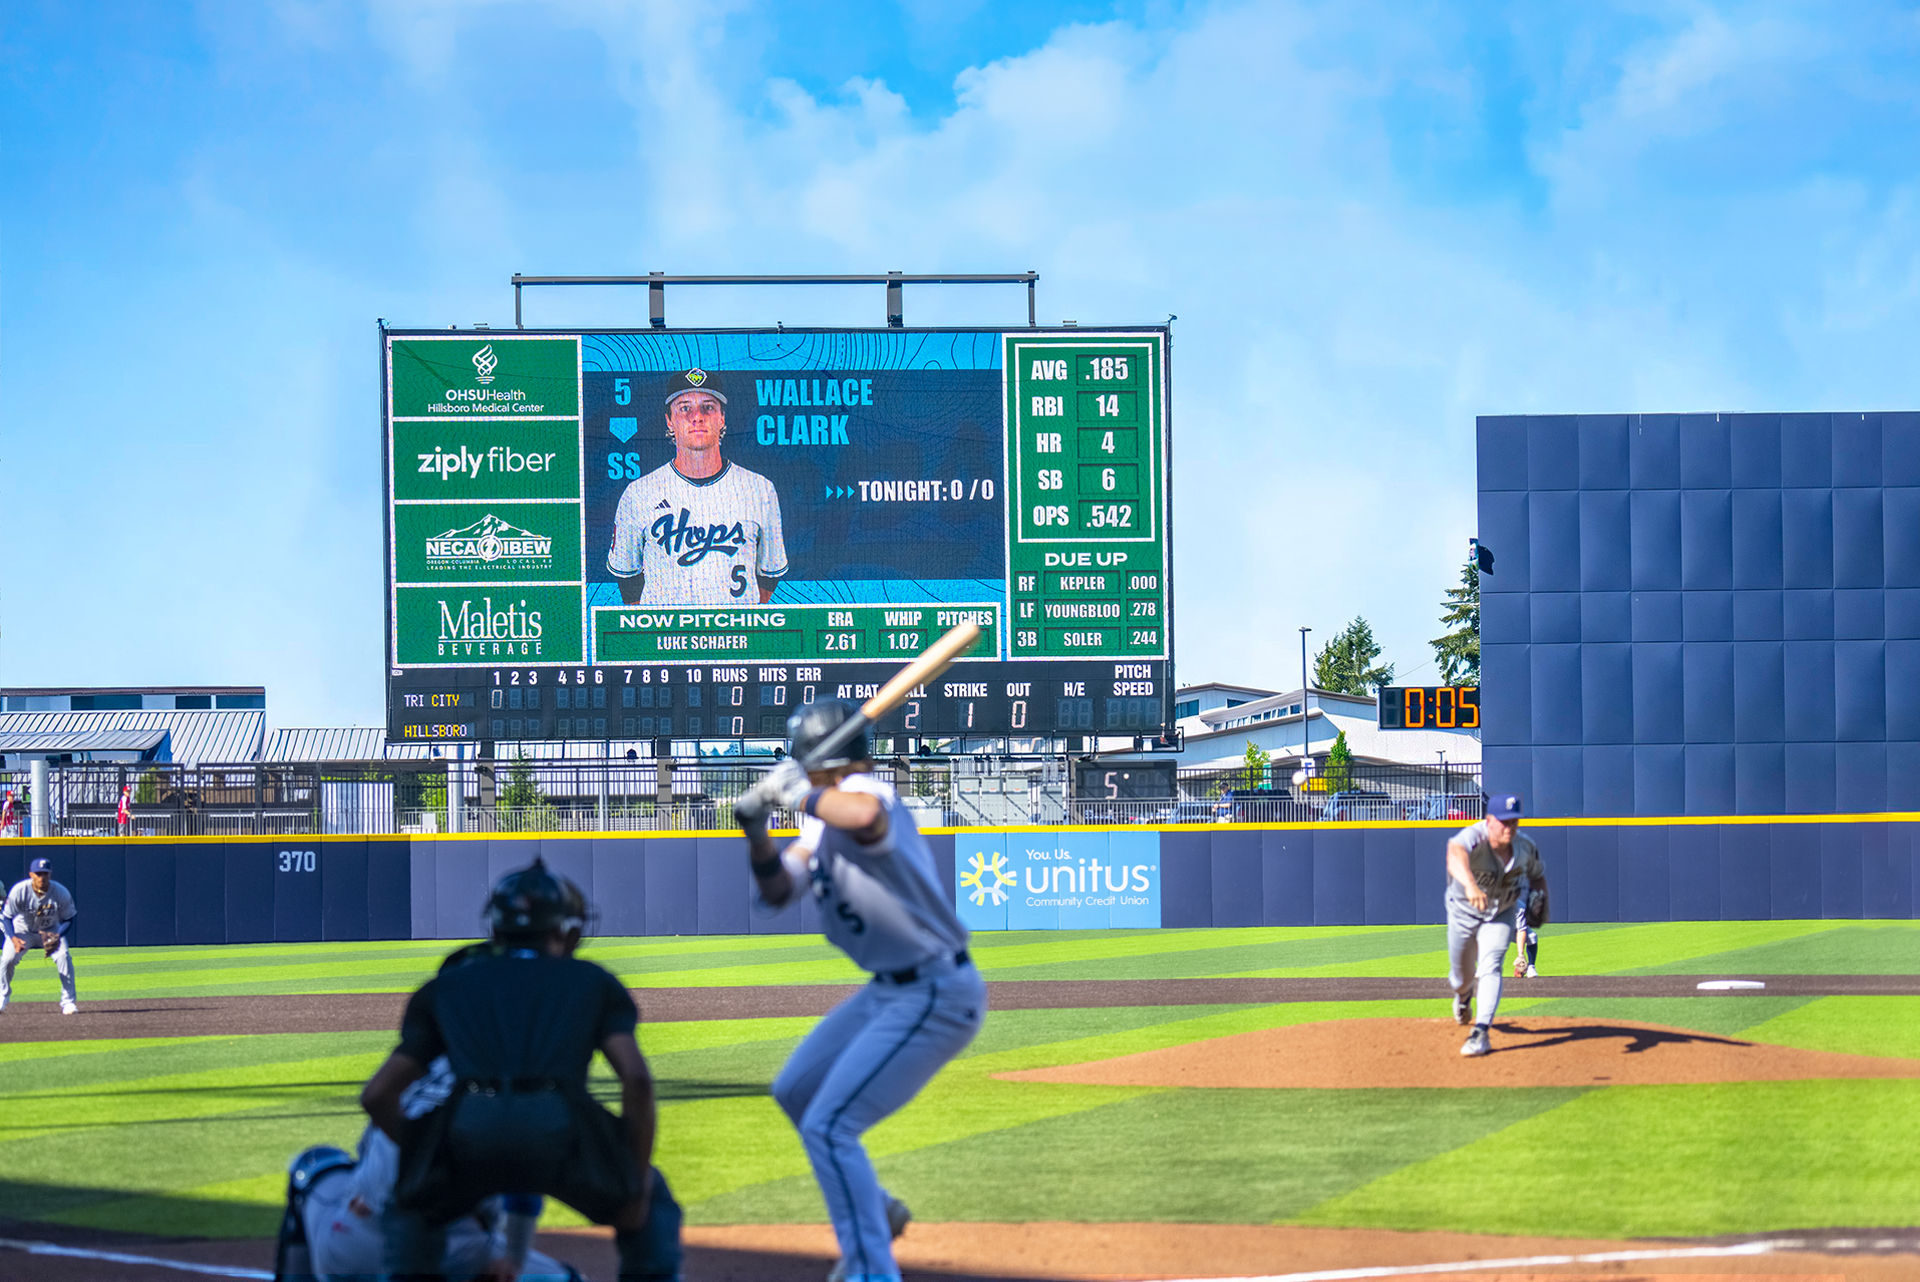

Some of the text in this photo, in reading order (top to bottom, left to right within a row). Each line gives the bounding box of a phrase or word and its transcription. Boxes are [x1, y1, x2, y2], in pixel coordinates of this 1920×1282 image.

[1031, 358, 1128, 380] AVG .185
[615, 378, 631, 406] 5
[756, 379, 873, 406] WALLACE
[428, 403, 544, 412] Hillsboro Medical Center
[1032, 395, 1119, 416] RBI 14
[756, 415, 850, 445] CLARK
[1036, 431, 1115, 454] HR 4
[418, 446, 556, 480] ziply fiber
[608, 452, 641, 480] SS
[1038, 468, 1115, 491] SB 6
[1033, 505, 1131, 527] OPS .542
[651, 508, 746, 566] Hops
[426, 541, 551, 555] NECA IBEW
[1045, 552, 1128, 566] DUE UP
[730, 565, 747, 597] 5
[1018, 576, 1157, 591] RF KEPLER .000
[438, 597, 542, 639] Maletis
[828, 611, 993, 626] ERA WHIP PITCHES
[1020, 602, 1156, 618] LF YOUNGBLOO .278
[620, 613, 786, 628] NOW PITCHING
[657, 635, 748, 650] LUKE SCHAFER
[825, 632, 919, 650] 2.61 1.02
[1018, 631, 1157, 646] 3B SOLER .244
[438, 643, 541, 655] BEVERAGE
[493, 667, 822, 685] 1 2 3 4 5 6 7 8 9 10 RUNS HITS ERR
[1114, 664, 1151, 679] PITCH
[732, 686, 743, 705] 0
[774, 686, 786, 705] 0
[804, 686, 815, 704] 0
[837, 684, 879, 698] AT BAT
[944, 683, 987, 697] STRIKE
[1006, 682, 1031, 697] OUT
[1064, 682, 1085, 696] H/E
[1113, 681, 1154, 696] SPEED
[404, 694, 460, 707] TRI CITY
[492, 690, 502, 708] 0
[1404, 687, 1479, 727] 0:05
[905, 701, 919, 729] 2
[967, 702, 973, 728] 1
[1012, 700, 1026, 728] 0
[404, 724, 467, 737] HILLSBORO
[732, 716, 743, 735] 0
[279, 851, 316, 872] 370
[1026, 849, 1072, 860] You. Us.
[1026, 858, 1149, 893] unitus
[1026, 896, 1149, 908] Community Credit Union
